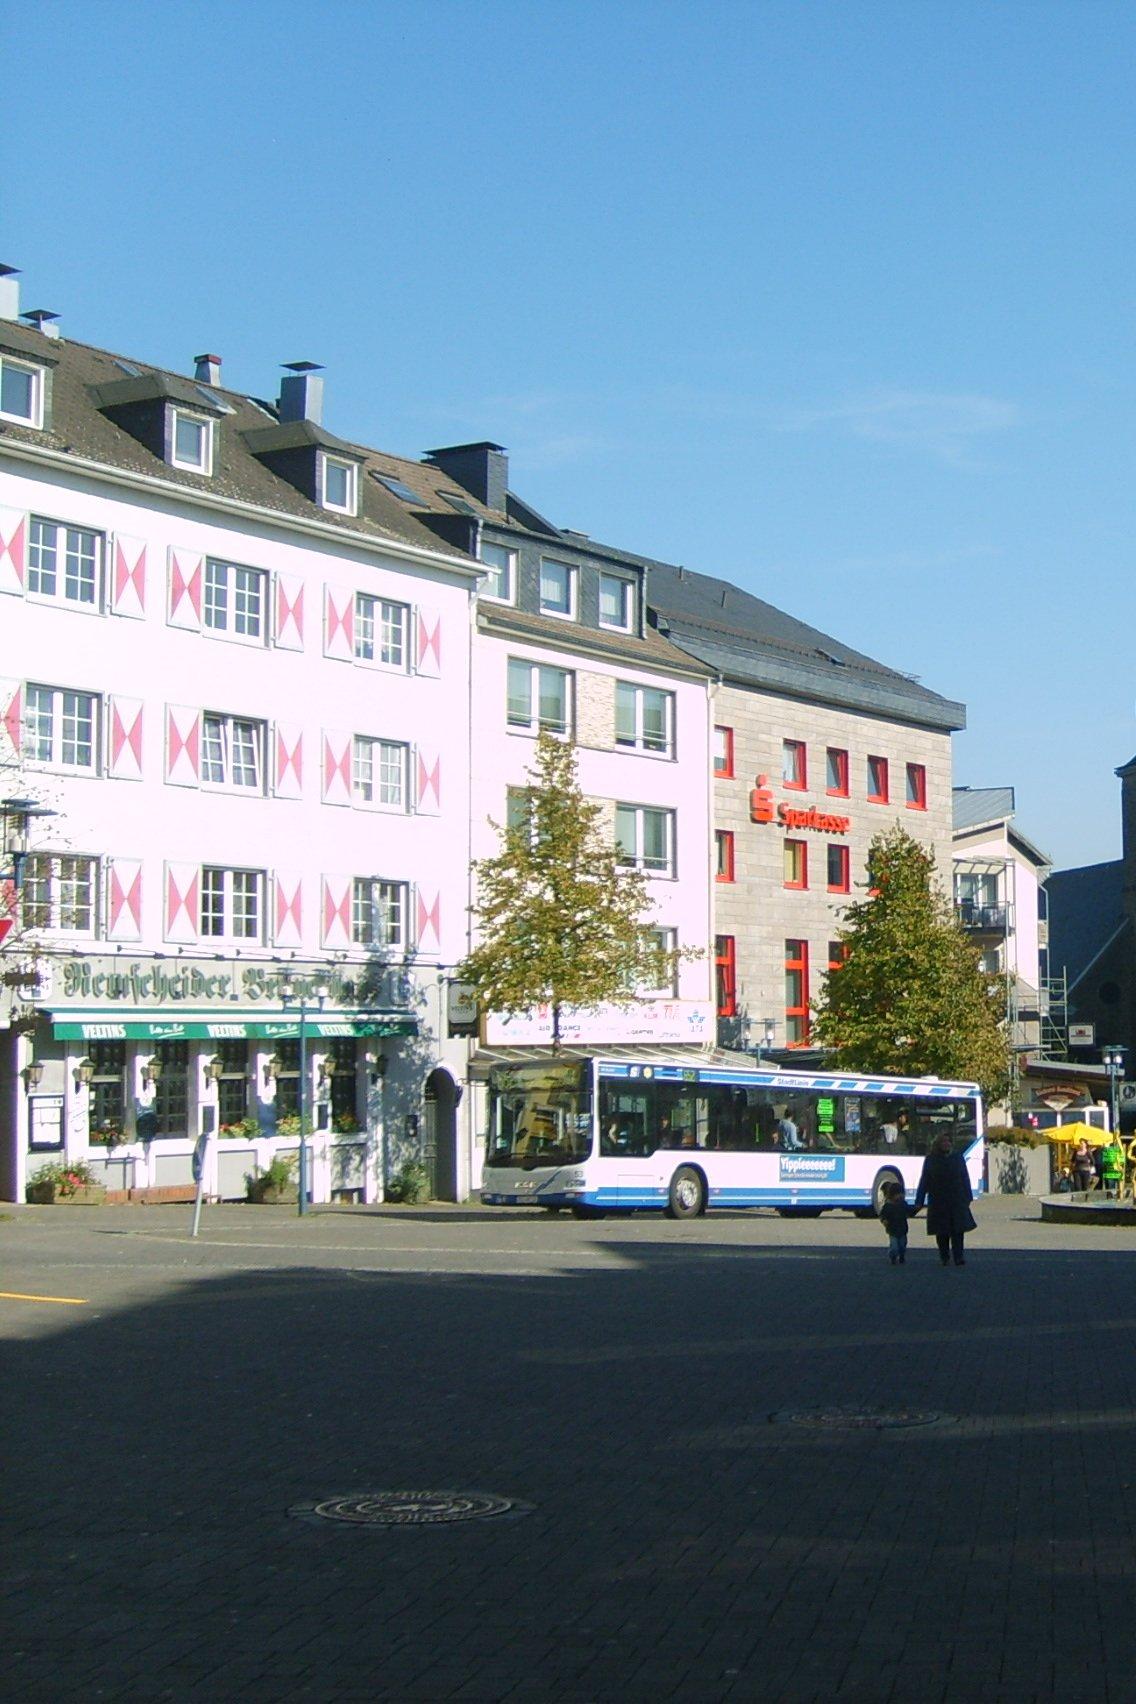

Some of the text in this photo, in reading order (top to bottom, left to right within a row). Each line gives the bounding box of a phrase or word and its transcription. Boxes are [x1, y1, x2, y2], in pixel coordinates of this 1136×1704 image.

[778, 802, 850, 835] Sparkasse
[81, 1024, 127, 1038] VELTINS
[207, 1024, 247, 1038] VELTINS
